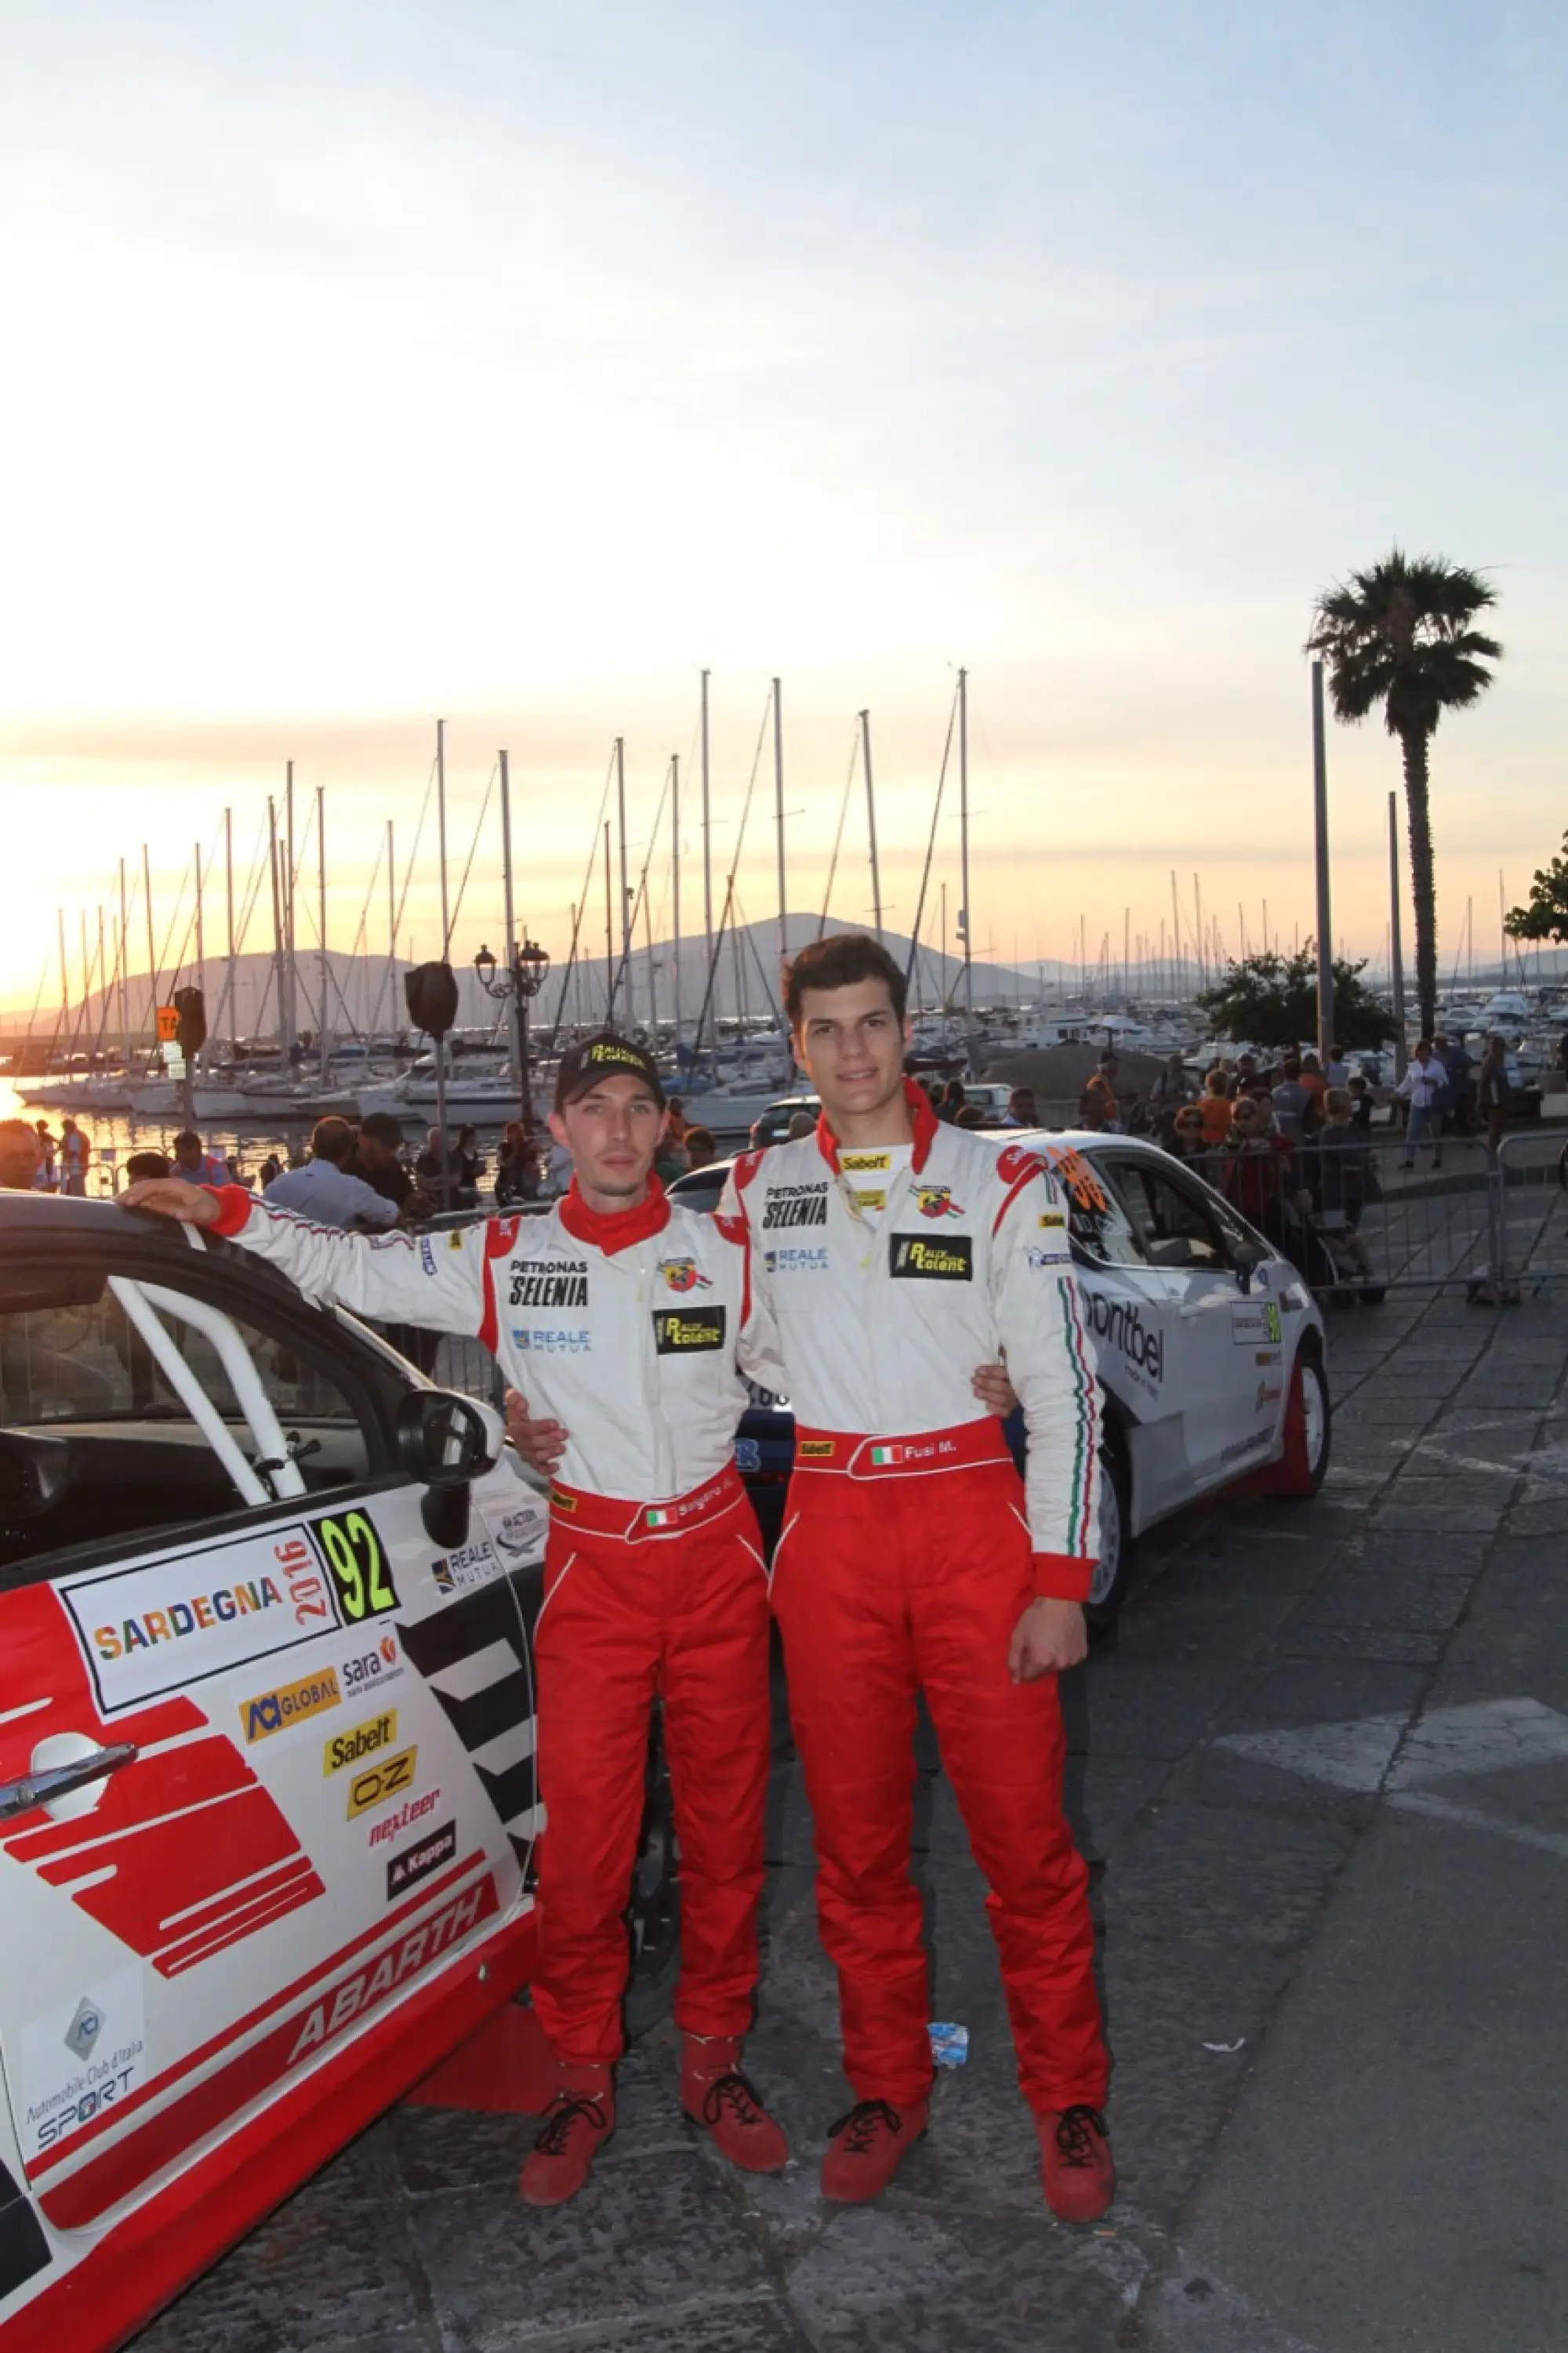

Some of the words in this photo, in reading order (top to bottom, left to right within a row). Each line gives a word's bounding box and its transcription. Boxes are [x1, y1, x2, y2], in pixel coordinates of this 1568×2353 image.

[767, 1182, 829, 1198] PETRONAS
[763, 1196, 827, 1229] SELENIA
[511, 1260, 587, 1273] PETRONAS
[779, 1249, 827, 1261] REALE
[510, 1276, 587, 1307] SELENIA
[533, 1331, 590, 1344] REALE
[320, 1511, 394, 1619] 92
[450, 1541, 492, 1573] REALE
[93, 1576, 283, 1661] SARDEGNA
[274, 1539, 327, 1625] 2016
[342, 1652, 381, 1687] sara
[281, 1679, 339, 1716] GLOBAL
[331, 1716, 390, 1769] Sabelt
[408, 1834, 452, 1872] Kappa
[286, 1886, 484, 2065] ABARTH
[27, 2077, 83, 2126] Automobile
[85, 2060, 110, 2086] Club
[38, 2065, 134, 2150] SPORT
